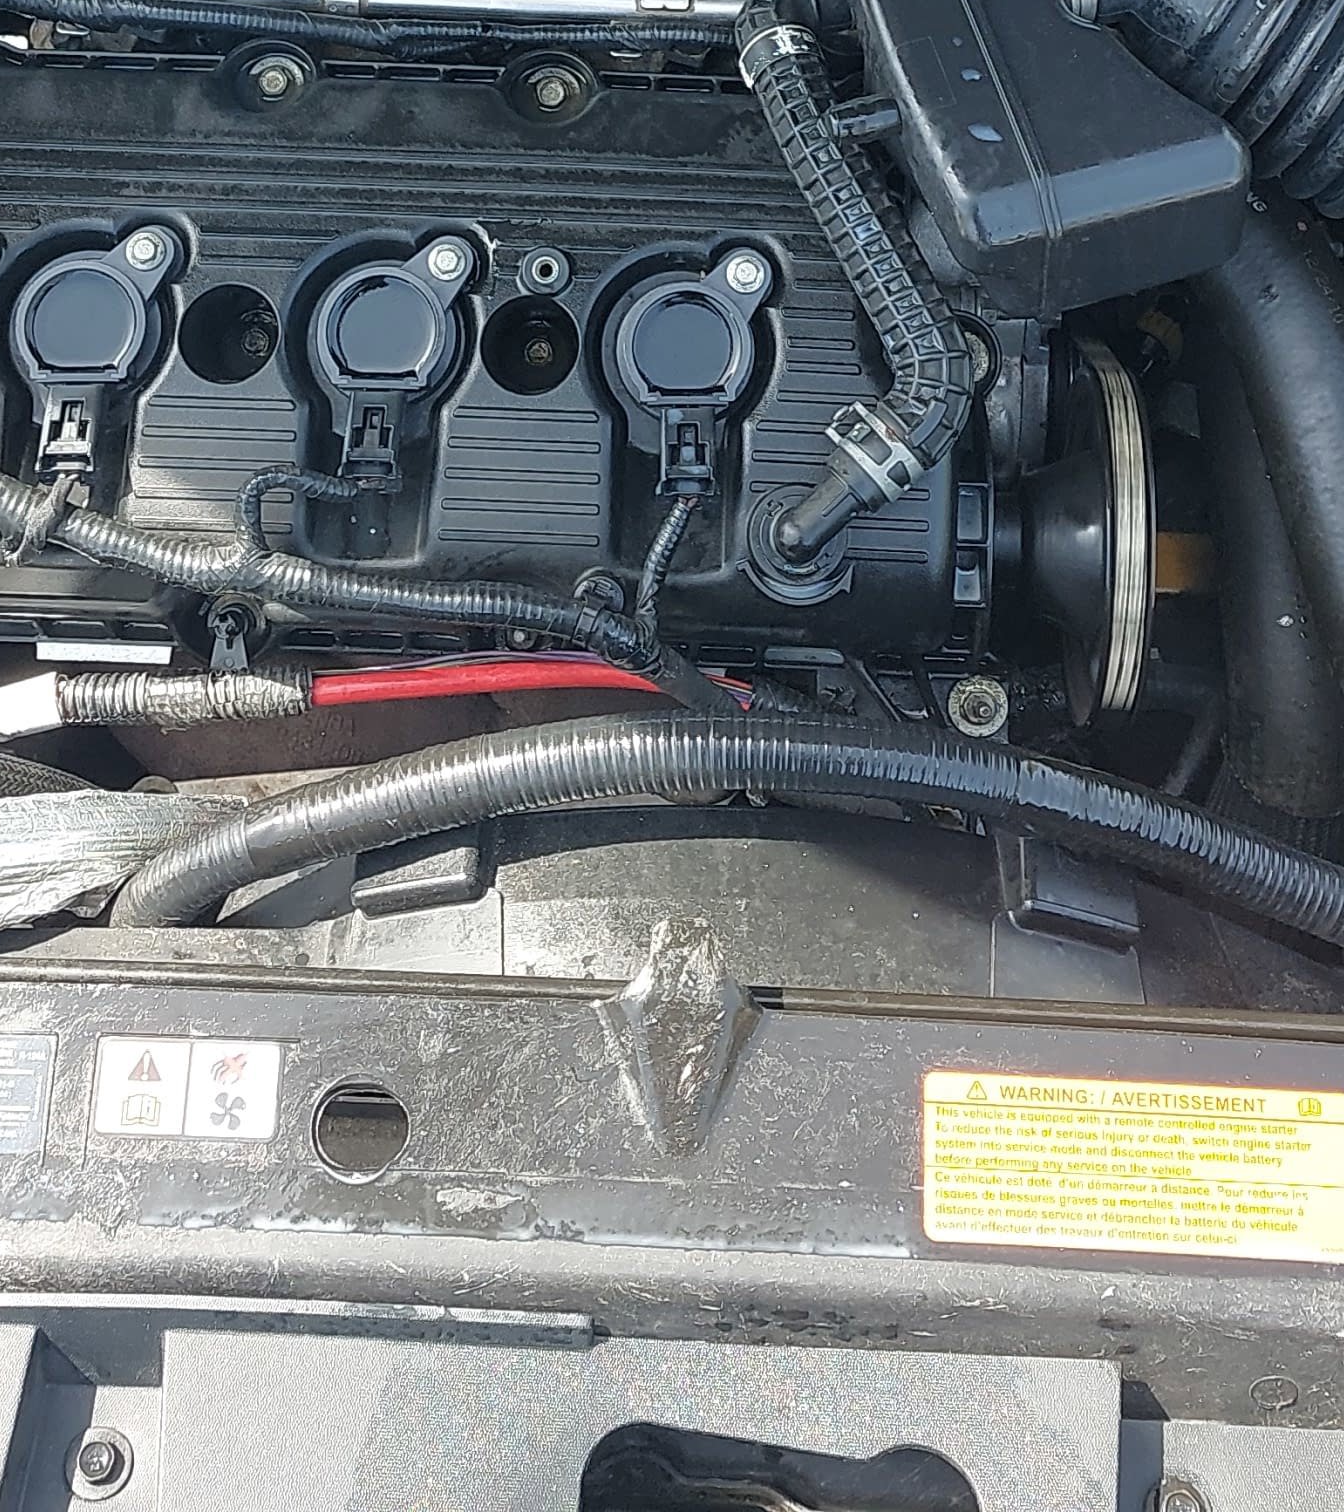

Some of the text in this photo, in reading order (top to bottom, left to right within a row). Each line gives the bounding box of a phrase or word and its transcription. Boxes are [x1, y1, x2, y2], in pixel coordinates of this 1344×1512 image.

[999, 1085, 1095, 1104] WARNING:
[1112, 1091, 1266, 1113] AVERTISSEMENT
[935, 1106, 958, 1117] This
[963, 1107, 1003, 1119] vehicle
[1007, 1110, 1016, 1120] is
[1020, 1110, 1073, 1125] equipped
[1077, 1113, 1100, 1124] with
[1114, 1116, 1153, 1127] remote
[1158, 1118, 1215, 1130] controlled
[1218, 1121, 1256, 1135] engine
[1261, 1124, 1297, 1135] starter
[935, 1121, 947, 1132] To
[952, 1122, 990, 1134] reduce
[995, 1124, 1012, 1135] the
[1017, 1125, 1036, 1136] risk
[1041, 1127, 1052, 1137] of
[1056, 1128, 1097, 1139] serious
[1138, 1134, 1148, 1142] or
[1192, 1135, 1228, 1147] switch
[1232, 1137, 1270, 1152] engine
[1275, 1140, 1312, 1151] starter
[935, 1139, 1282, 1167] system into service mode and disconnect the vehicle battery
[935, 1153, 971, 1164] before
[975, 1156, 1038, 1172] performing
[1042, 1160, 1063, 1172] any
[1067, 1160, 1107, 1171] service
[1111, 1164, 1126, 1172] on
[1129, 1163, 1143, 1173] the
[935, 1171, 950, 1182] Ce
[1006, 1175, 1023, 1186] est
[935, 1186, 977, 1200] risques
[981, 1189, 995, 1200] de
[999, 1190, 1055, 1203] blessures
[1059, 1194, 1097, 1208] graves
[1102, 1197, 1116, 1206] ou
[1180, 1200, 1216, 1212] mettre
[1220, 1202, 1230, 1212] le
[935, 1202, 984, 1216] distance
[988, 1207, 1001, 1216] en
[1005, 1206, 1038, 1218] mode
[1041, 1208, 1083, 1220] service
[1170, 1214, 1180, 1225] la
[1184, 1215, 1228, 1228] batterie
[1231, 1217, 1245, 1229] du
[935, 1218, 966, 1231] avant
[1036, 1223, 1056, 1235] des
[1060, 1224, 1103, 1238] travaux
[1173, 1232, 1190, 1242] sur
